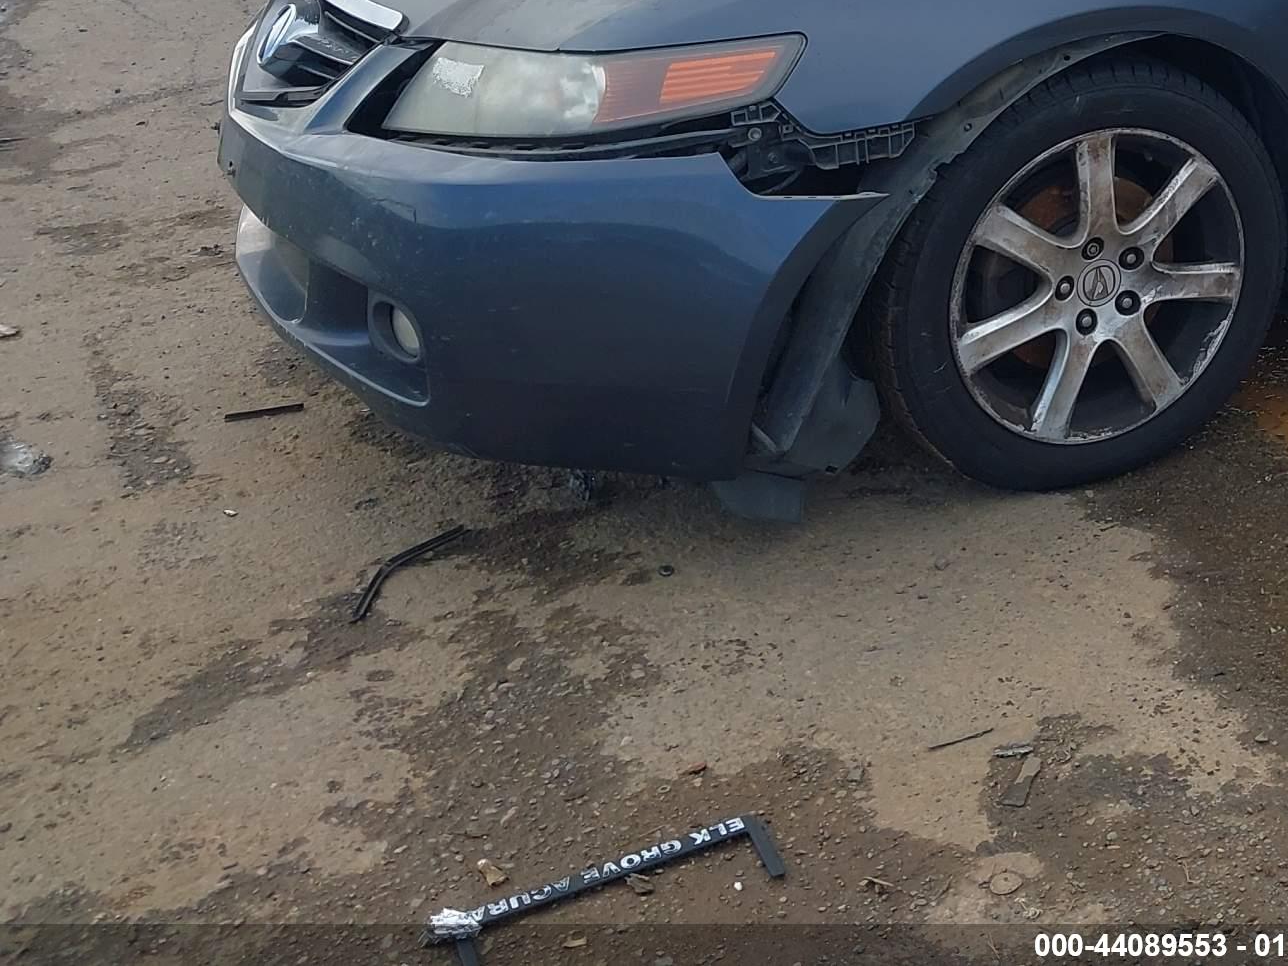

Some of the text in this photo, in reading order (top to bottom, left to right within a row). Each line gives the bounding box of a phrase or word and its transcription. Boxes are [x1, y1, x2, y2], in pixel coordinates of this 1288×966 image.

[471, 817, 746, 923] ELK GROVE ACURA
